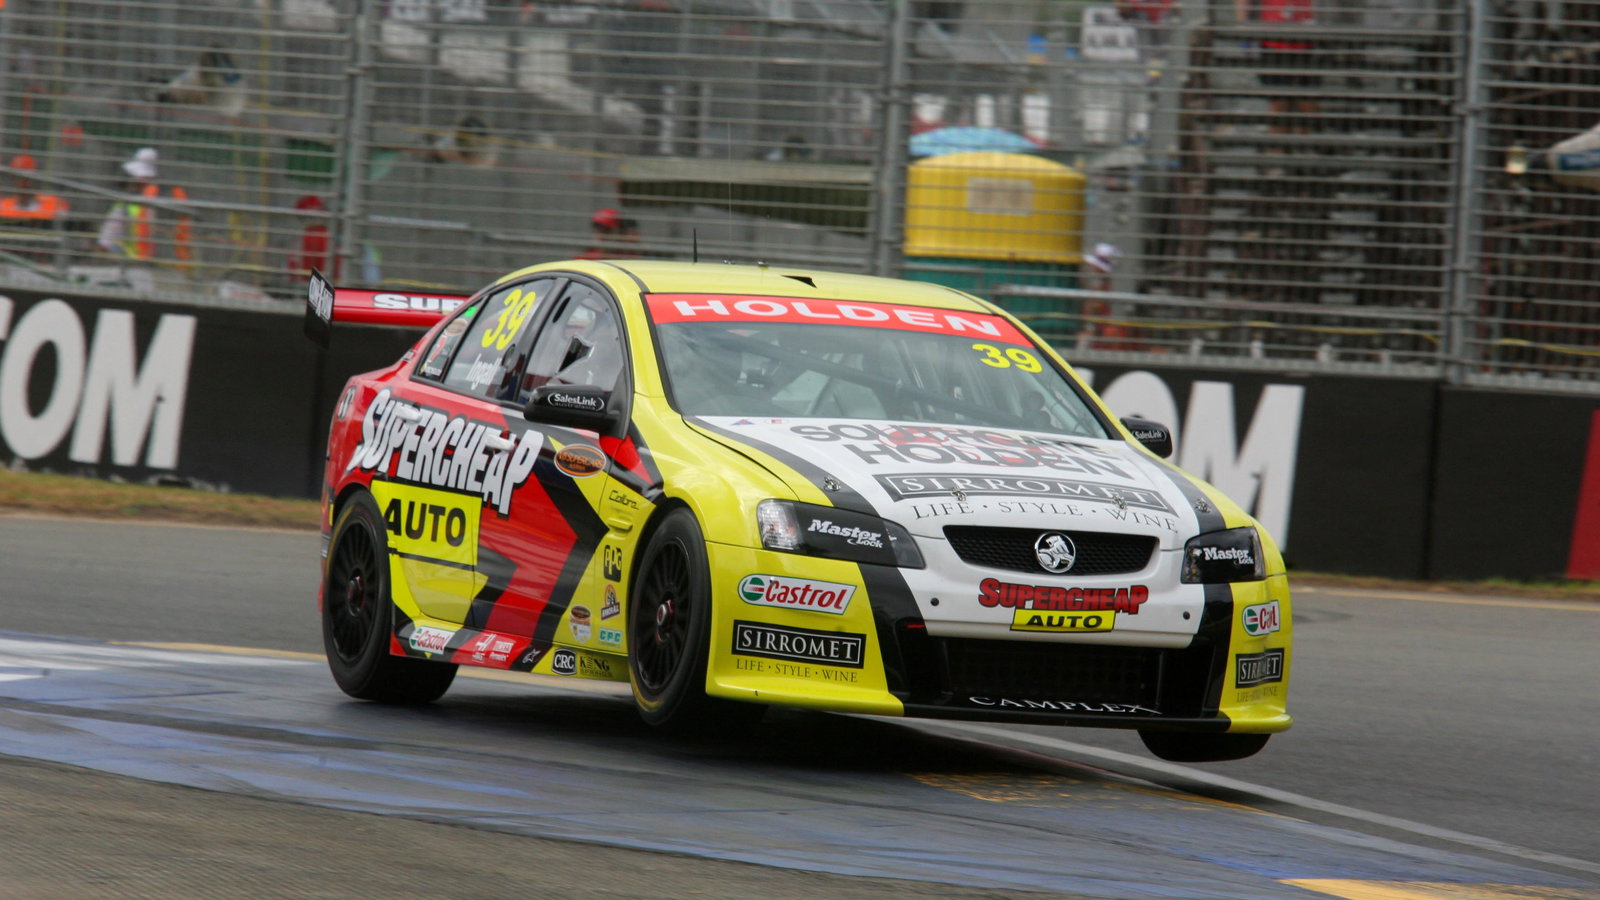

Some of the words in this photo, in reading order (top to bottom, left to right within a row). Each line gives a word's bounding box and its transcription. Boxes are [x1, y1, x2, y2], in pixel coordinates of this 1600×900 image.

[481, 289, 536, 351] 39
[673, 299, 1001, 337] HOLDEN
[972, 343, 1042, 374] 39
[553, 393, 597, 406] SalesLink
[346, 388, 543, 515] SUPERCHEAP
[842, 443, 1136, 481] HOLDEN
[901, 477, 1150, 504] SIRROMET
[382, 498, 467, 547] AUTO
[807, 519, 882, 542] Master
[912, 501, 975, 520] LIFE
[998, 502, 1083, 517] STYLE
[1105, 507, 1179, 534] WINE
[856, 536, 883, 549] Lock
[1203, 547, 1249, 561] Master
[765, 579, 849, 610] Castrol
[978, 578, 1149, 615] SUPERCHEAP
[600, 630, 622, 643] CPC
[1027, 615, 1103, 629] AUTO
[741, 629, 857, 660] SIRROMET
[554, 654, 575, 669] CRC
[736, 658, 765, 672] LIFE
[776, 664, 811, 678] STYLE
[822, 669, 859, 683] WINE
[969, 696, 1163, 715] CAMPLEX
